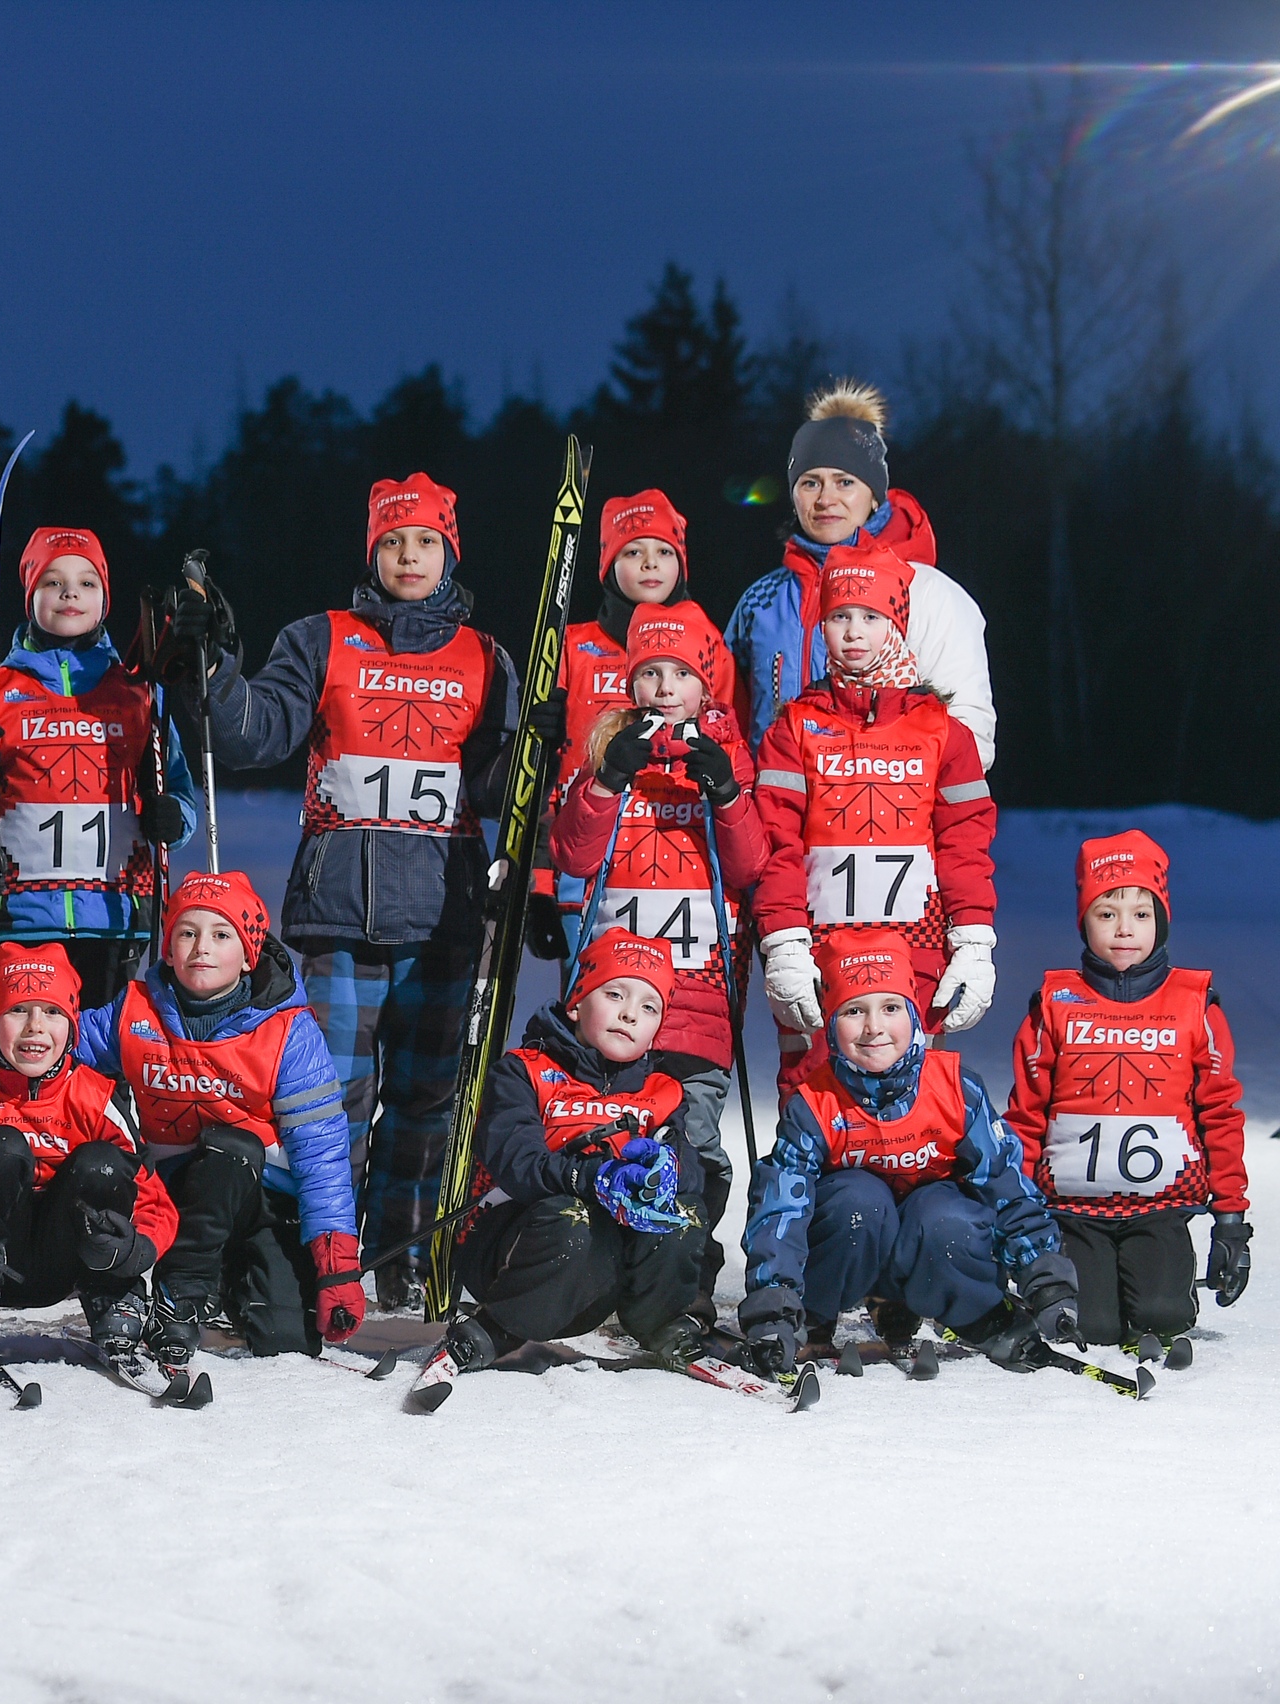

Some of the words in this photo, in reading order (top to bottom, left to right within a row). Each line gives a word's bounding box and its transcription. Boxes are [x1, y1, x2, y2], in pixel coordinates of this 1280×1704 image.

[555, 533, 577, 609] FISCHER
[358, 667, 464, 701] IZsnega
[359, 660, 434, 672] СПОРТИВНЫЙ
[439, 665, 465, 676] КЛУБ
[21, 716, 124, 743] IZsnega
[506, 627, 559, 863] FISCER
[817, 743, 889, 752] СПОРТИВНЫЙ
[816, 752, 924, 782] IZsnega
[363, 764, 448, 824] 15
[39, 810, 106, 868] 11
[831, 853, 915, 917] 17
[615, 896, 699, 959] 14
[4, 963, 56, 976] IZsnega
[840, 954, 893, 969] IZsnega
[1066, 1011, 1145, 1021] СПОРТИВНЫЙ
[1150, 1013, 1177, 1021] КЛУБ
[1065, 1020, 1177, 1051] IZsnega
[141, 1062, 244, 1098] IZsnega
[846, 1133, 916, 1149] ПОРТИВНЫЙ
[1078, 1122, 1164, 1184] 16
